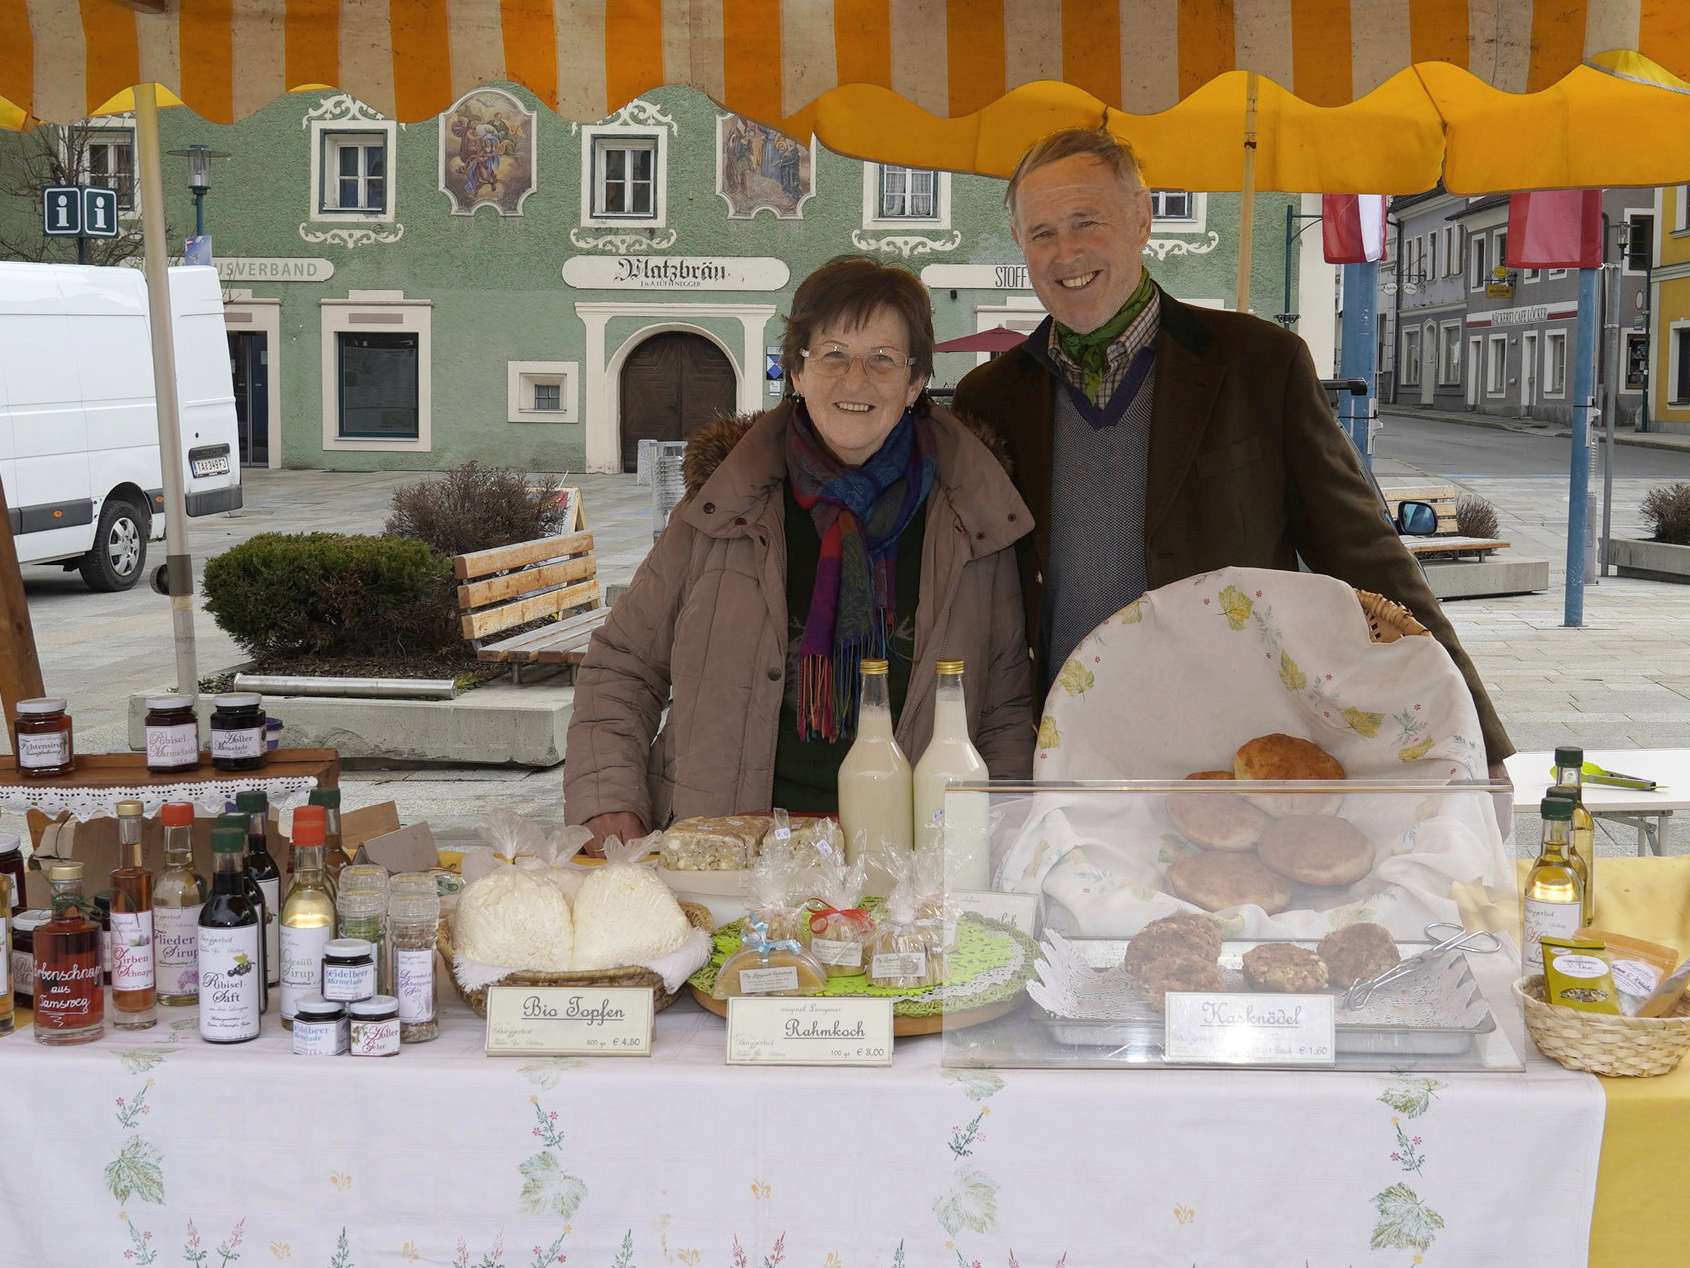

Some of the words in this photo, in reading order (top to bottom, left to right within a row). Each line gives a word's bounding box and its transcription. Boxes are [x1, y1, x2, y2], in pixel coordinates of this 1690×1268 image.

[212, 990, 241, 1004] Saft
[522, 995, 558, 1017] Bio
[566, 995, 625, 1026] Topfen
[785, 1018, 866, 1037] Rahmkoch
